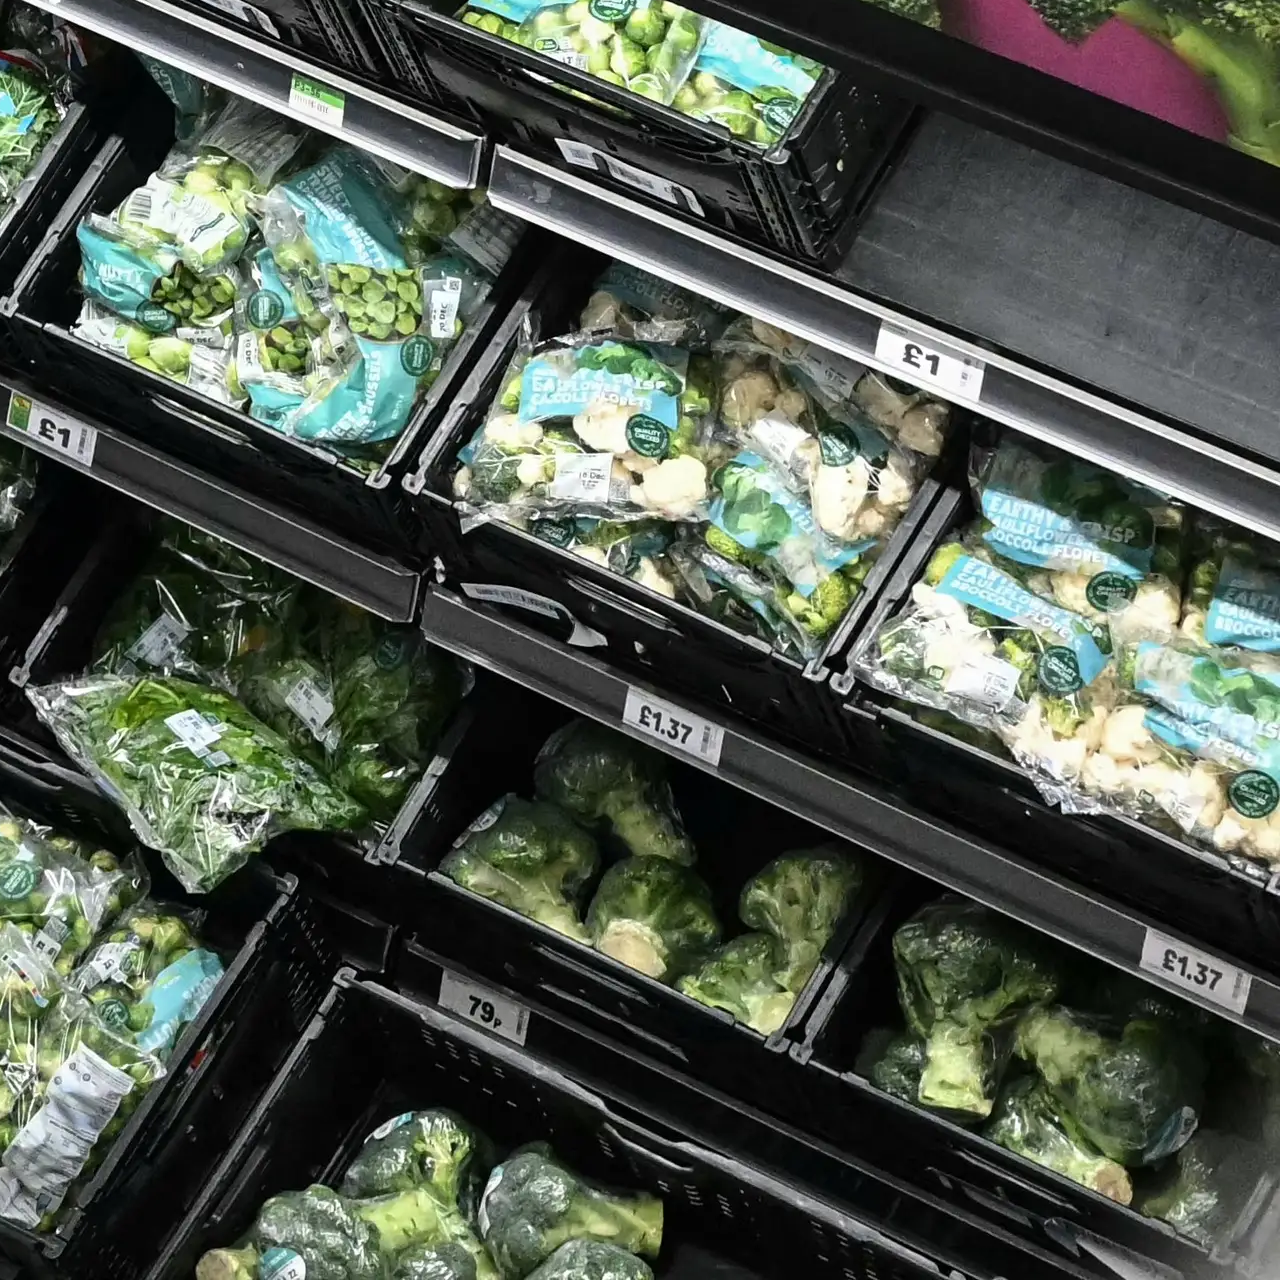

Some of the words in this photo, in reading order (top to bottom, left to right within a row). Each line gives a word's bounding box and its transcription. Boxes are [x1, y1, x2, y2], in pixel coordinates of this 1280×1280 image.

[902, 343, 941, 376] £1
[38, 417, 71, 449] £1
[989, 496, 1056, 526] EARTHY
[1083, 520, 1136, 543] CRISP
[638, 704, 694, 746] £1.37
[1162, 948, 1224, 991] £1.37
[468, 995, 503, 1029] 79p
